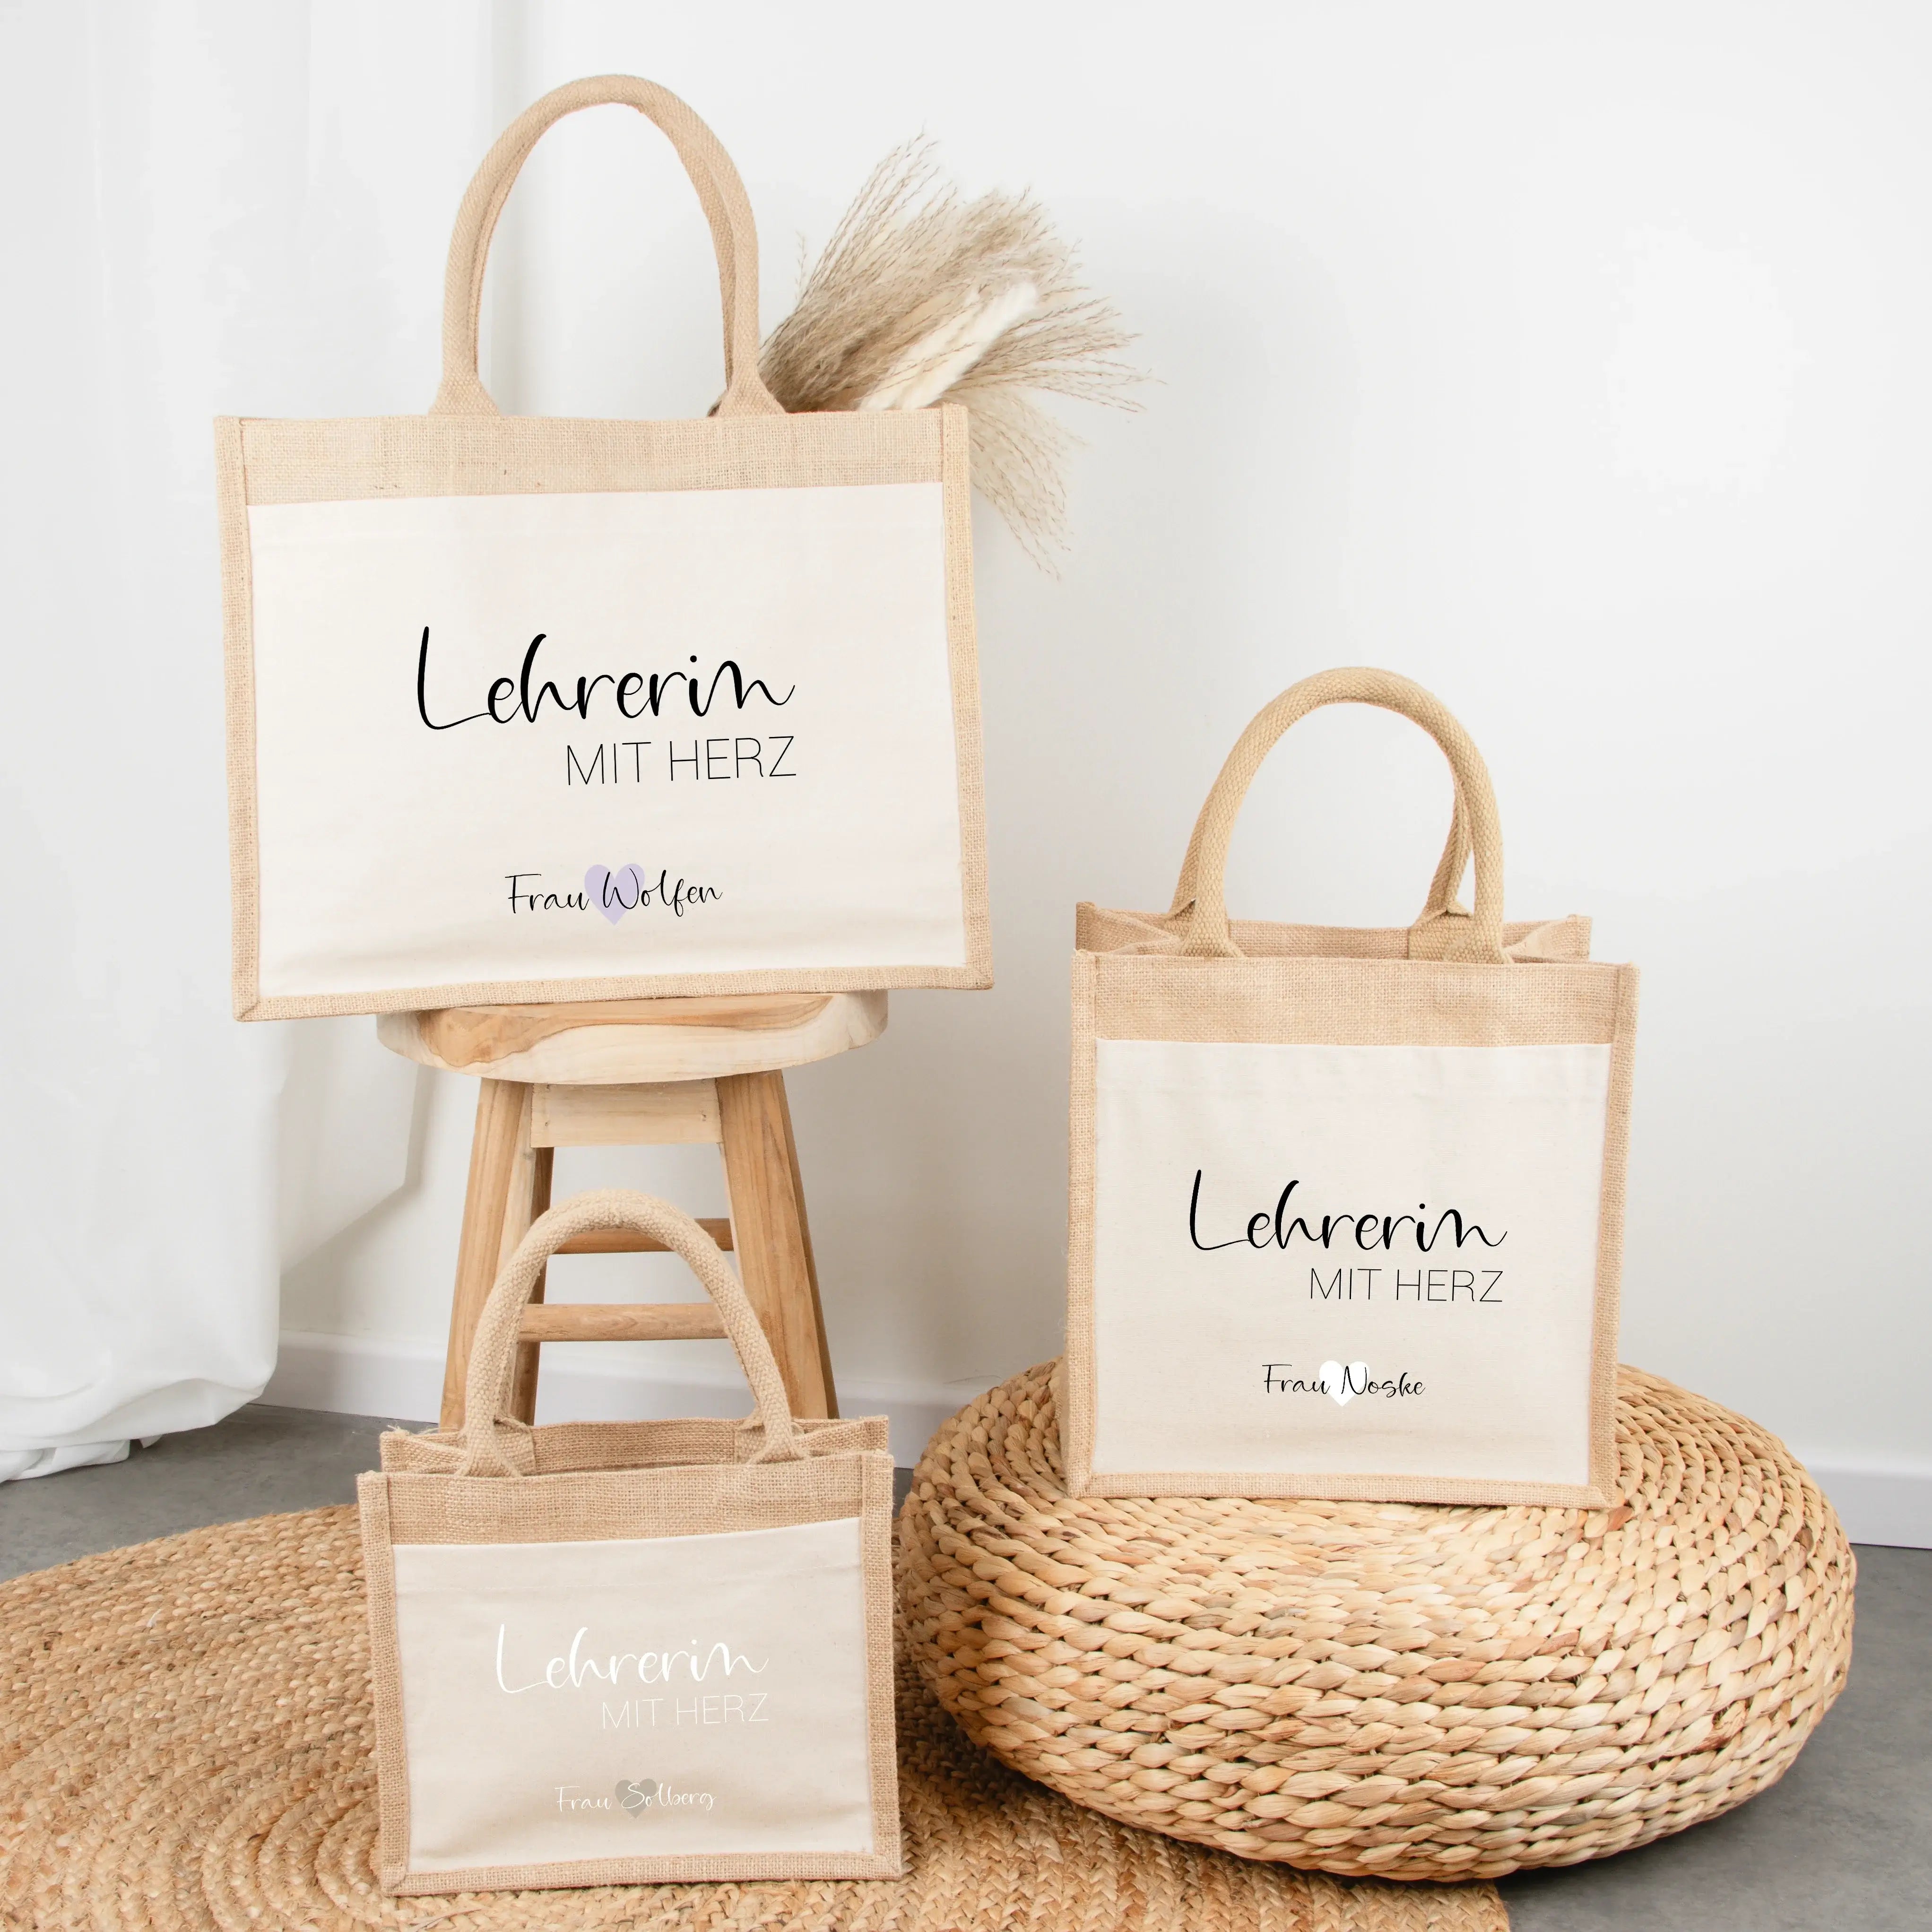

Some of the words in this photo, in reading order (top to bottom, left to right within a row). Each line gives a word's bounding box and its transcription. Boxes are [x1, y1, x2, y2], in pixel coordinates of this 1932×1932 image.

[417, 626, 796, 730] Lehrerin
[567, 742, 651, 786] MIT
[669, 736, 797, 781] HERZ
[504, 874, 590, 914] Frau
[602, 868, 723, 917] Wolfen
[1189, 1169, 1508, 1252] Lehrerin
[1310, 1268, 1382, 1300] MIT
[1396, 1269, 1504, 1302] HERZ
[1262, 1364, 1331, 1395] Frau
[1341, 1365, 1426, 1398] Noske
[496, 1624, 769, 1694] Lehrerin
[602, 1698, 664, 1729] MIT
[676, 1693, 770, 1725] HERZ
[554, 1786, 613, 1812] Frau
[621, 1782, 717, 1811] Solberg
